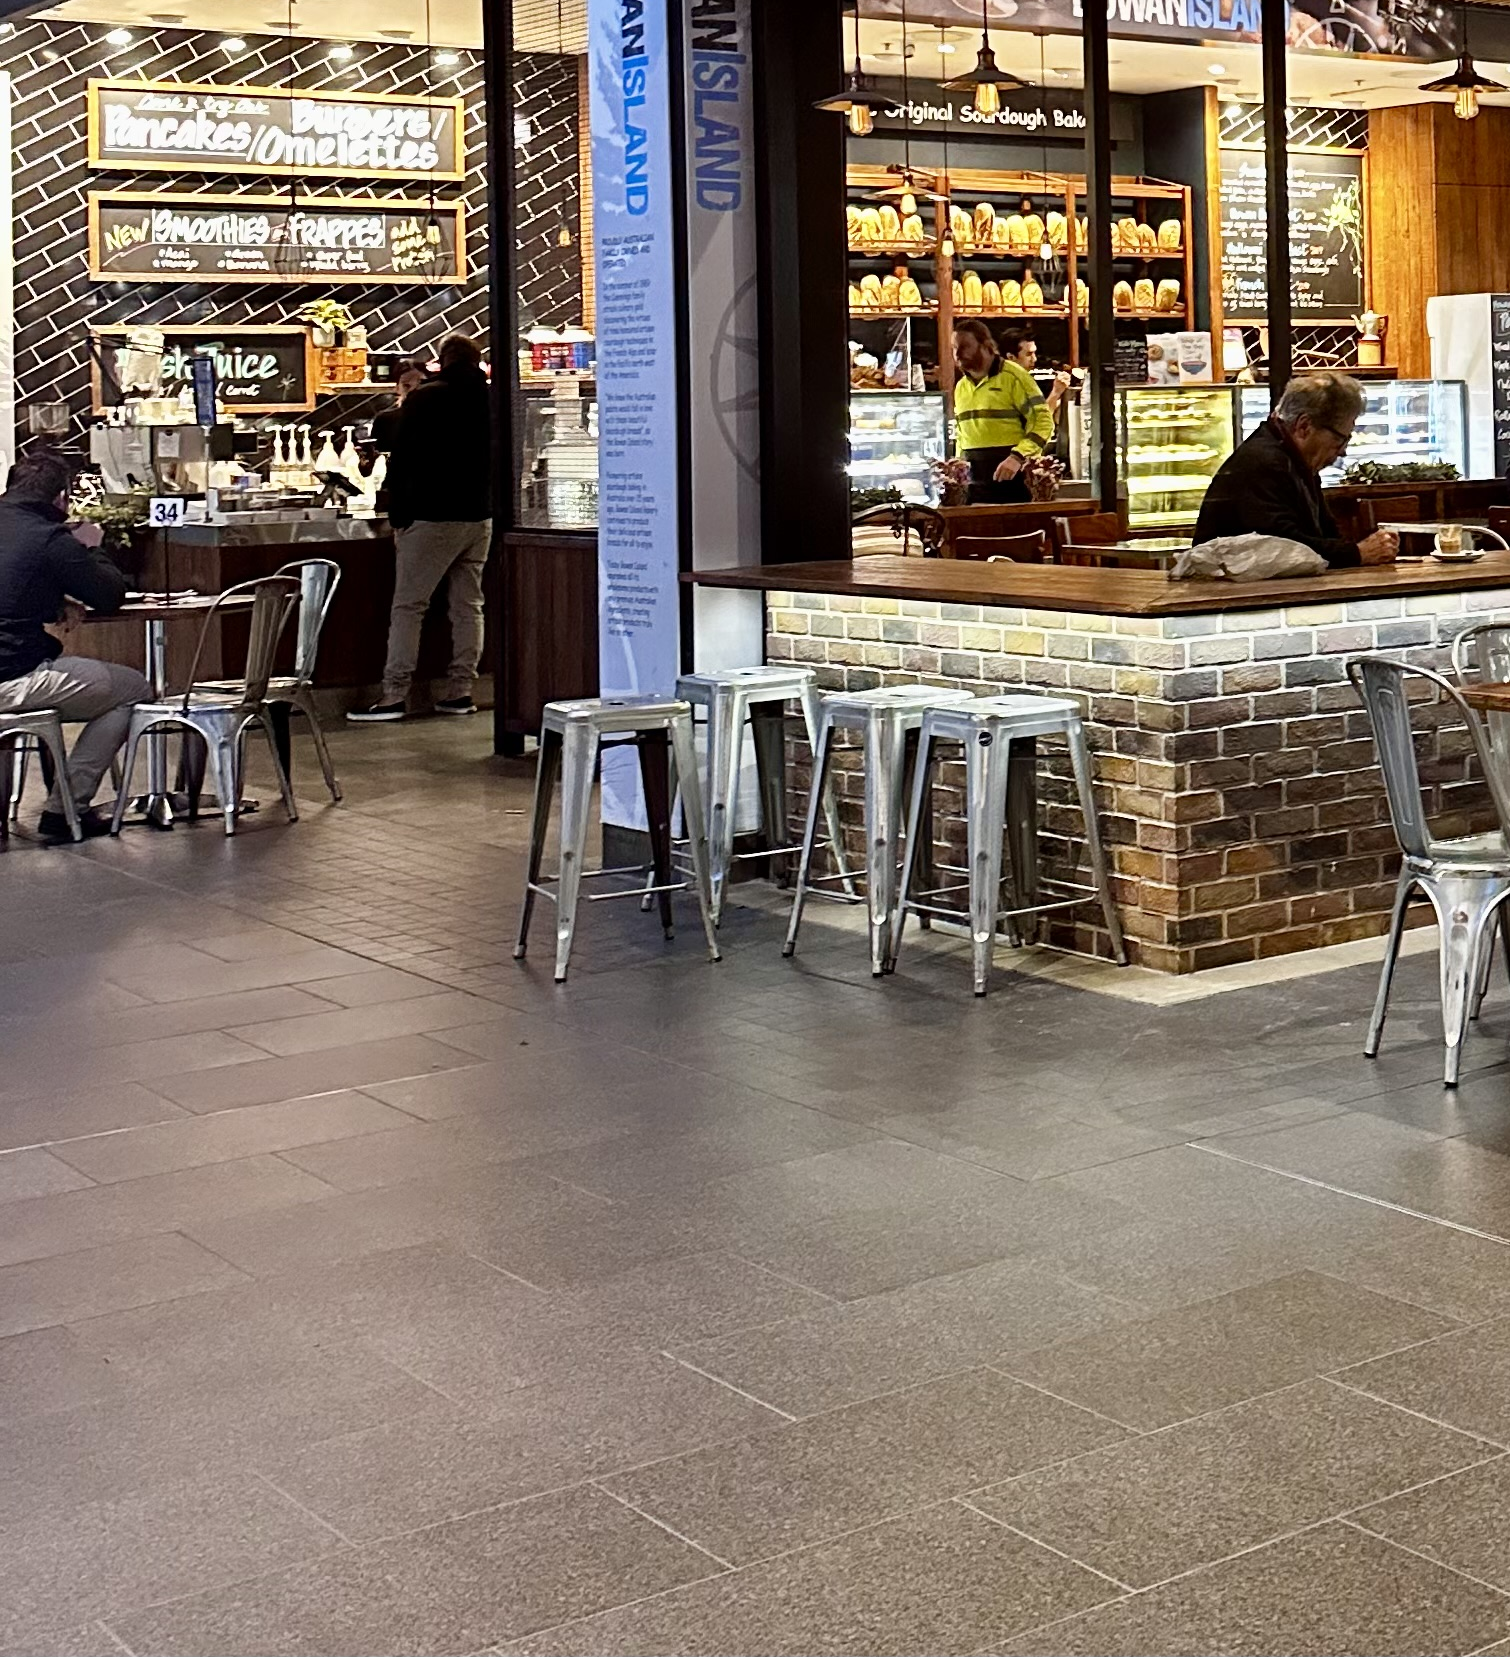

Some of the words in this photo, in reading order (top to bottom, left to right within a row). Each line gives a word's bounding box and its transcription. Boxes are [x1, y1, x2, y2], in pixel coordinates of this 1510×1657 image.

[959, 105, 1048, 131] Sourdough
[1053, 108, 1086, 129] Bak
[103, 217, 151, 252] NEW
[154, 502, 178, 522] 34
